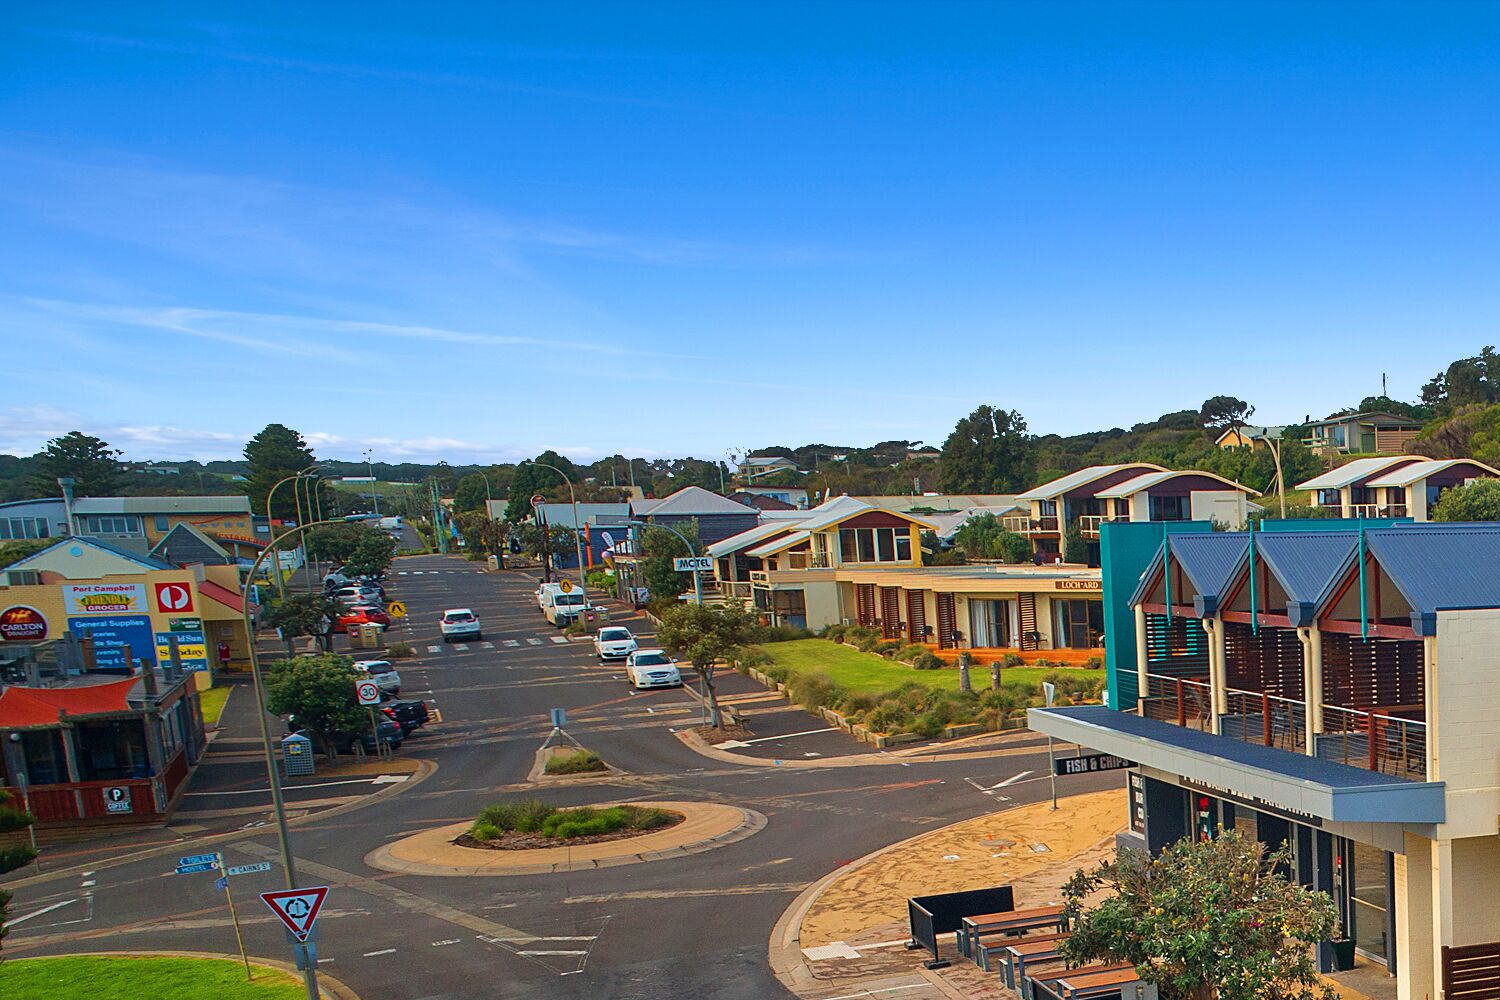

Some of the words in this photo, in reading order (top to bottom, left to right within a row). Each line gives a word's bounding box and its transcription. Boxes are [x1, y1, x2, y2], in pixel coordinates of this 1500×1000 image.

[94, 585, 136, 593] Campbell
[1, 623, 44, 631] CARLTON
[108, 619, 145, 628] Supplies
[362, 687, 375, 697] 30
[1066, 758, 1089, 774] FISH
[1089, 757, 1098, 771] &
[1099, 755, 1129, 770] CHIPS
[187, 854, 215, 863] TOILETS
[181, 864, 207, 873] HOSTEL
